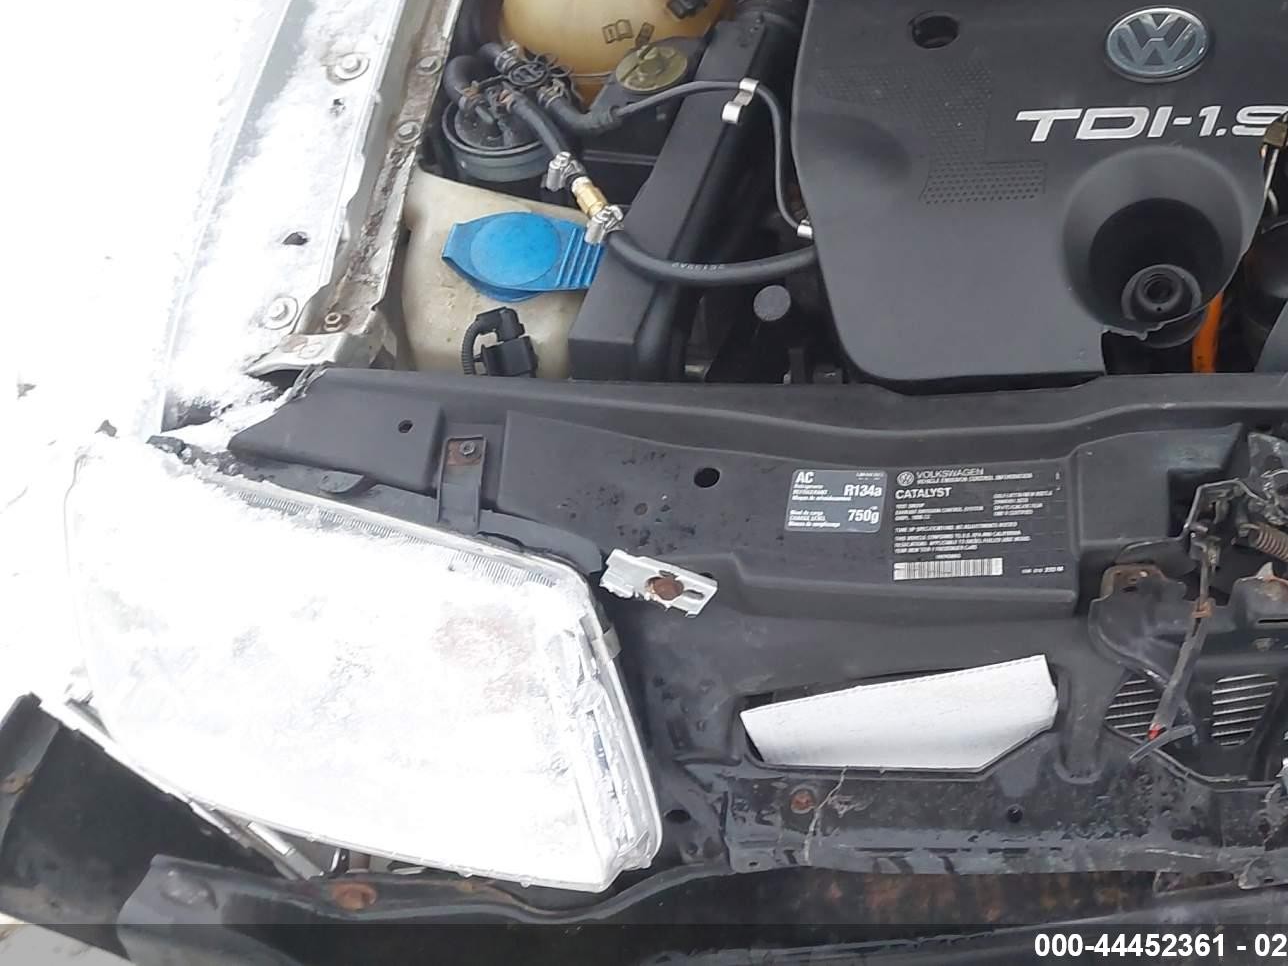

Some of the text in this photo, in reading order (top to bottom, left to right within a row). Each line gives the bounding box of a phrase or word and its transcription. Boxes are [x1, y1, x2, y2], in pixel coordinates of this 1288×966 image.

[795, 471, 814, 484] AC
[916, 468, 984, 479] VOLKSWAGEN
[843, 484, 882, 497] R134a
[895, 487, 952, 500] CATALYST
[847, 509, 880, 524] 750g
